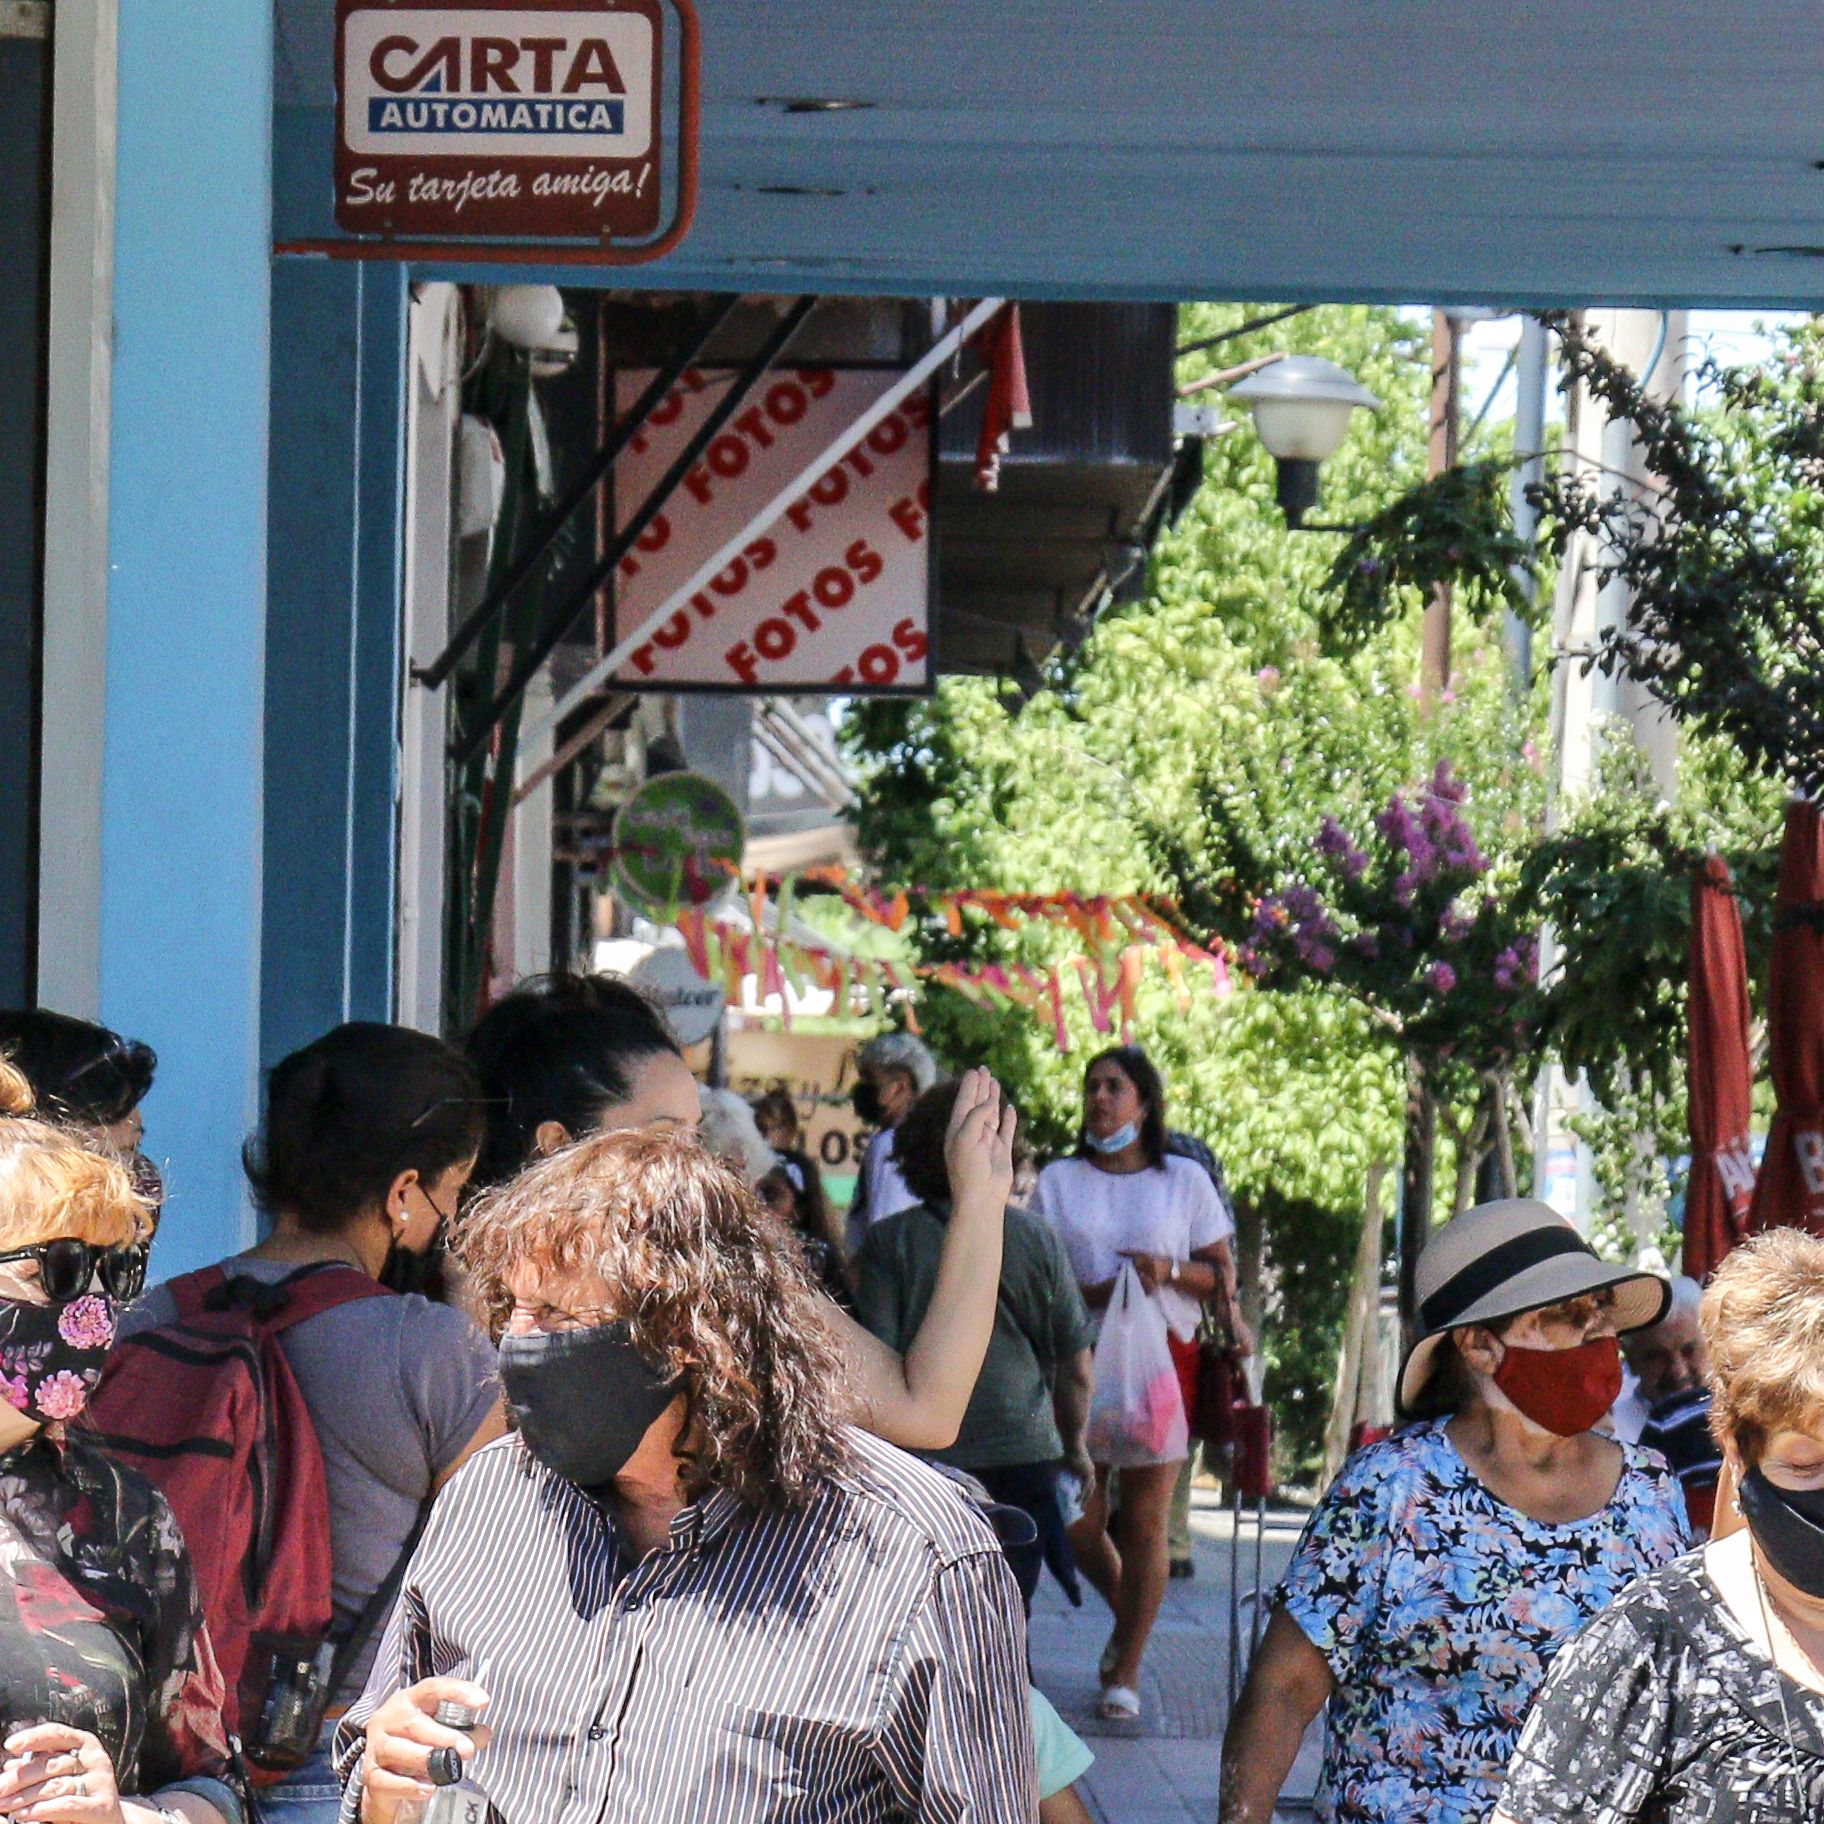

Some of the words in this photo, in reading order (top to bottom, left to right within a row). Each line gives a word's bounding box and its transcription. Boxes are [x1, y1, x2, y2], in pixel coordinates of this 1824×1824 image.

[370, 35, 626, 93] CARTA
[380, 103, 613, 130] AUTOMATICA
[347, 167, 394, 205] Su
[409, 168, 521, 213] tarjeta
[532, 162, 652, 207] amiga!
[725, 538, 884, 684] FOTOS
